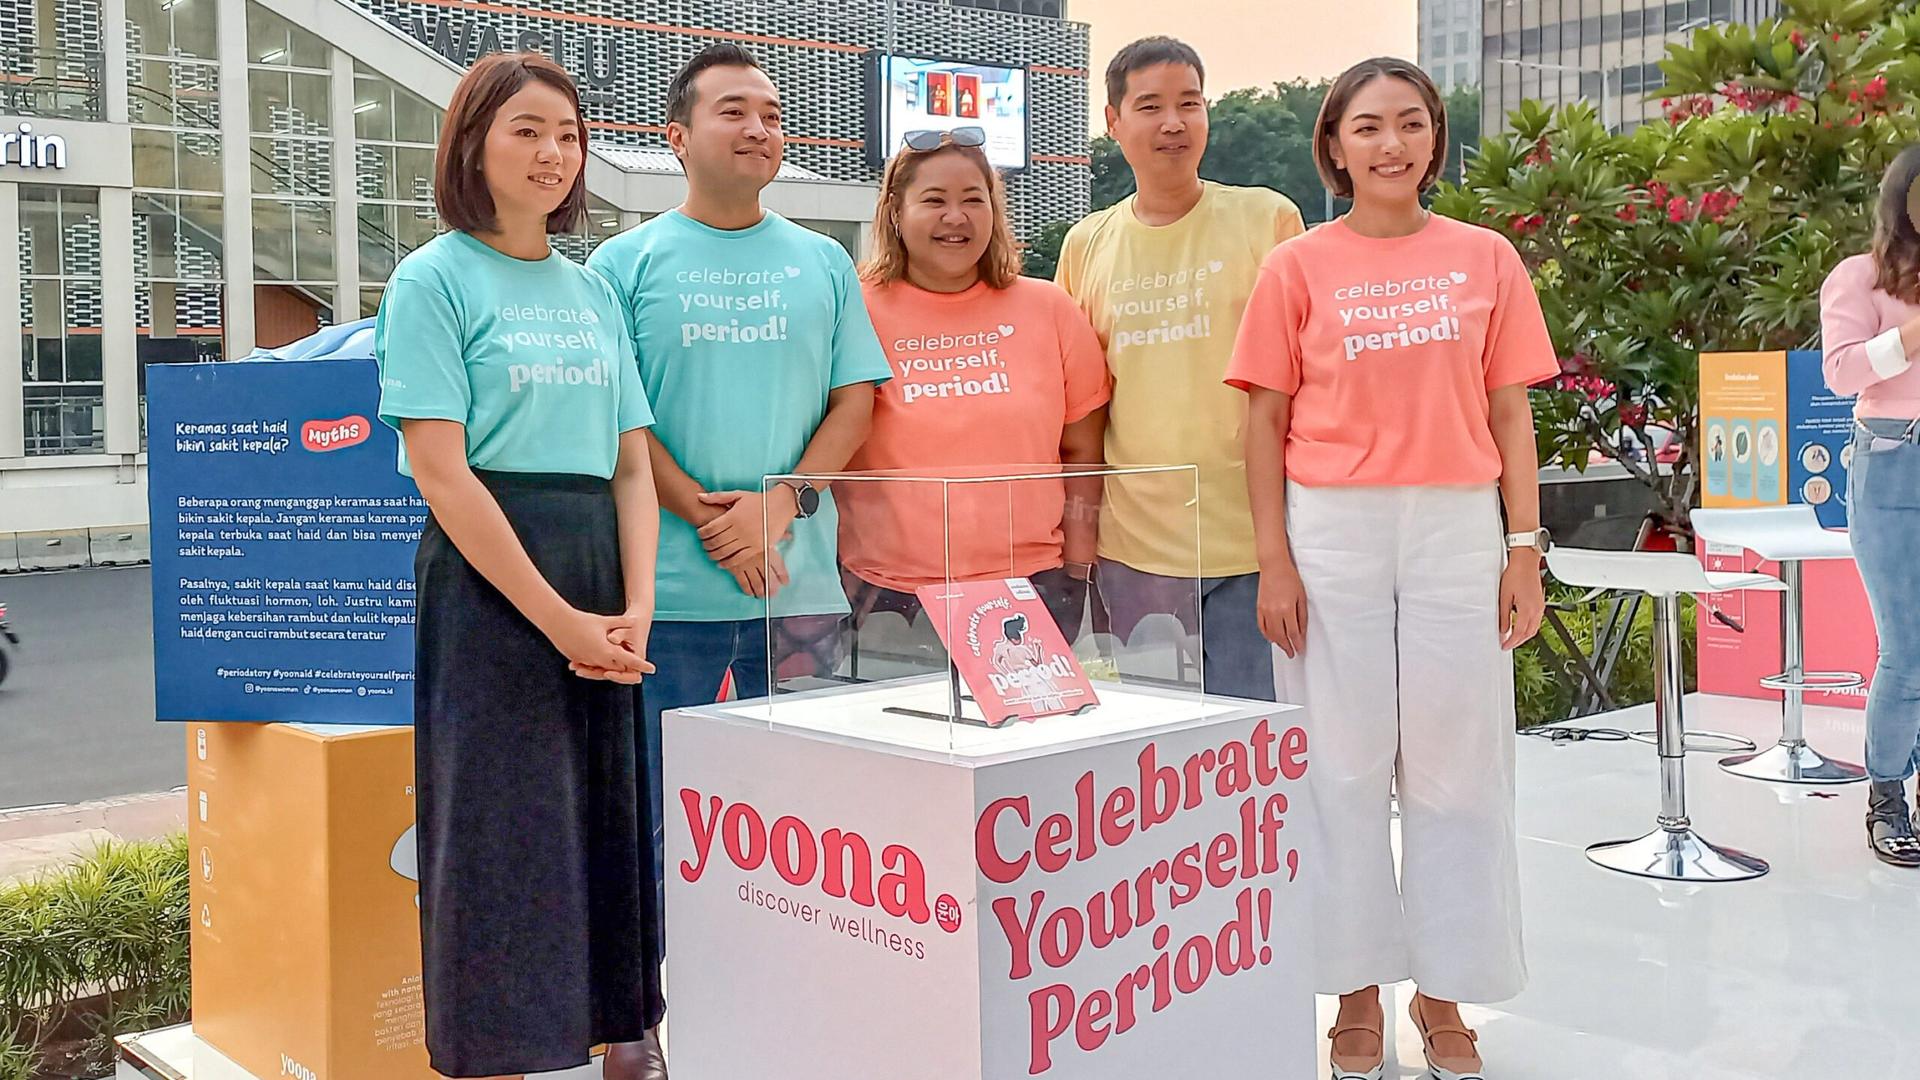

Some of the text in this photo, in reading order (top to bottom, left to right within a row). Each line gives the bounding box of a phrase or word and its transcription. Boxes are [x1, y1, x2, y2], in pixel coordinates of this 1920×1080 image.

[0, 122, 66, 168] rin
[676, 268, 785, 285] celebrate
[1335, 275, 1451, 300] celebrate
[679, 290, 788, 313] yourself,
[1339, 294, 1457, 326] yourself,
[500, 330, 606, 353] yourself,
[681, 315, 788, 347] period!
[894, 331, 999, 352] celebrate
[1114, 314, 1211, 353] period!
[1343, 316, 1460, 360] period!
[507, 357, 609, 392] period!
[898, 349, 1006, 378] yourself,
[902, 372, 1010, 403] period!
[176, 420, 289, 434] Keramas saat haid
[308, 423, 359, 447] Myths
[176, 435, 291, 454] bikin sakit kepala?
[178, 496, 229, 509] Beberapa
[230, 499, 261, 509] orang
[263, 498, 332, 509] menganggap
[334, 495, 381, 506] keramas
[383, 496, 407, 506] saat
[178, 512, 428, 526] bikin sakit kepala. Jangan keramas karena por
[179, 529, 214, 542] kepala
[220, 528, 263, 539] terbuka
[268, 530, 291, 539] saat
[297, 528, 321, 539] haid
[326, 528, 347, 539] dan
[353, 529, 376, 539] bisa
[179, 545, 245, 558] sakit kepala.
[180, 578, 230, 590] Pasalnya,
[234, 578, 261, 588] sakit
[265, 578, 301, 591] kepala
[305, 579, 329, 589] saat
[333, 578, 364, 589] kamu
[368, 579, 392, 589] haid
[180, 594, 204, 604] oleh
[209, 594, 260, 605] fluktuasi
[265, 595, 312, 607] hormon,
[318, 595, 339, 605] loh.
[344, 596, 382, 606] Justru
[180, 611, 226, 624] menjaga
[227, 611, 285, 621] kebersihan
[288, 611, 329, 622] rambut
[330, 612, 351, 622] dan
[353, 612, 379, 622] kulit
[180, 626, 386, 640] haid dengan cuci rambut secara teratur
[217, 668, 272, 679] #periodstory
[273, 669, 313, 679] #yoonaid
[975, 719, 1308, 883] Celebrate
[992, 793, 1298, 980] Yourself,
[738, 880, 925, 960] discover wellness
[1028, 887, 1272, 1075] Period!
